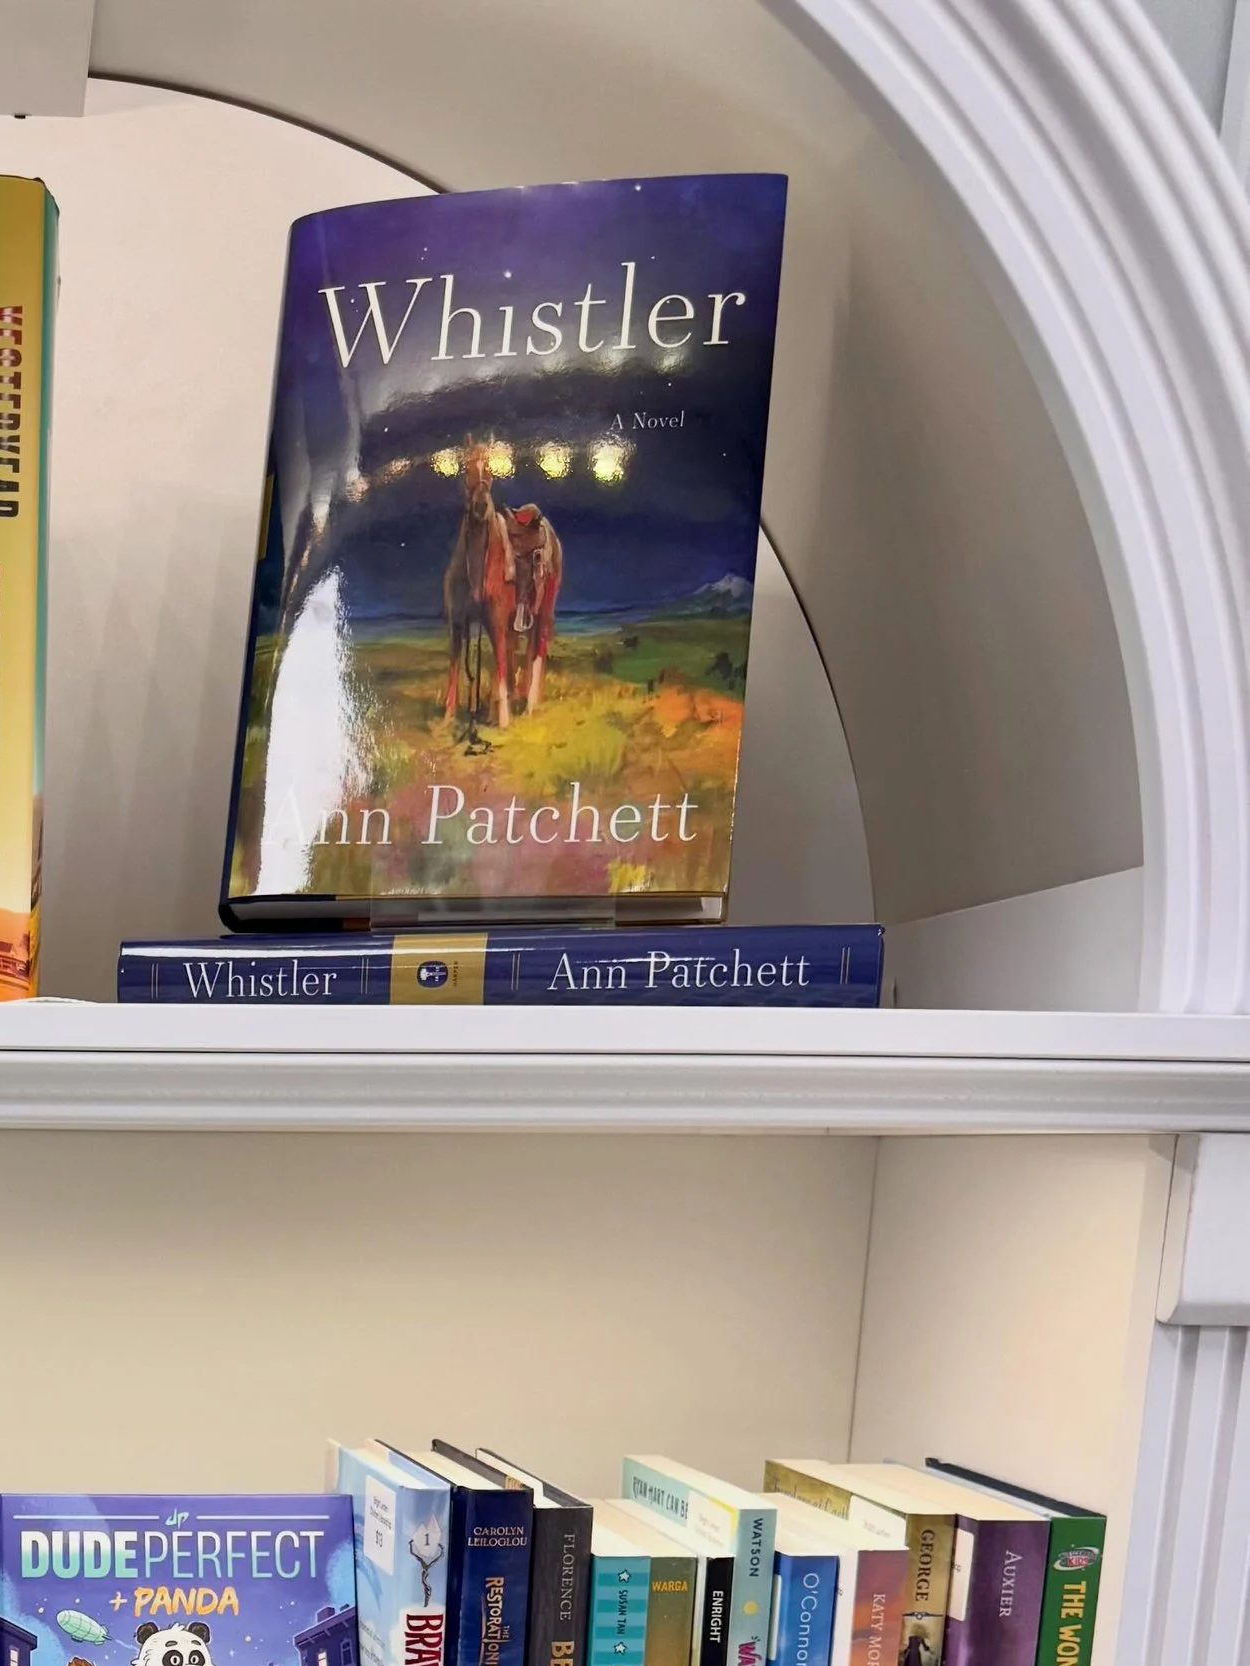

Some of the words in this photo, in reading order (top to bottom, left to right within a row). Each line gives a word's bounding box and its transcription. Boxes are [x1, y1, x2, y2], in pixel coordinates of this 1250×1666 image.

[318, 262, 745, 367] Whistler
[611, 412, 624, 430] A
[633, 411, 686, 430] Novel
[422, 783, 699, 847] Patchett
[183, 959, 338, 1000] Whistler
[548, 952, 630, 993] Ann
[644, 949, 811, 989] Patchett
[467, 1536, 528, 1548] LEILOGLOU
[473, 1526, 525, 1537] CAROLYN
[19, 1528, 138, 1580] DUDE
[143, 1529, 325, 1580] PERFECT
[133, 1586, 240, 1617] PANDA
[1060, 1580, 1087, 1619] THE
